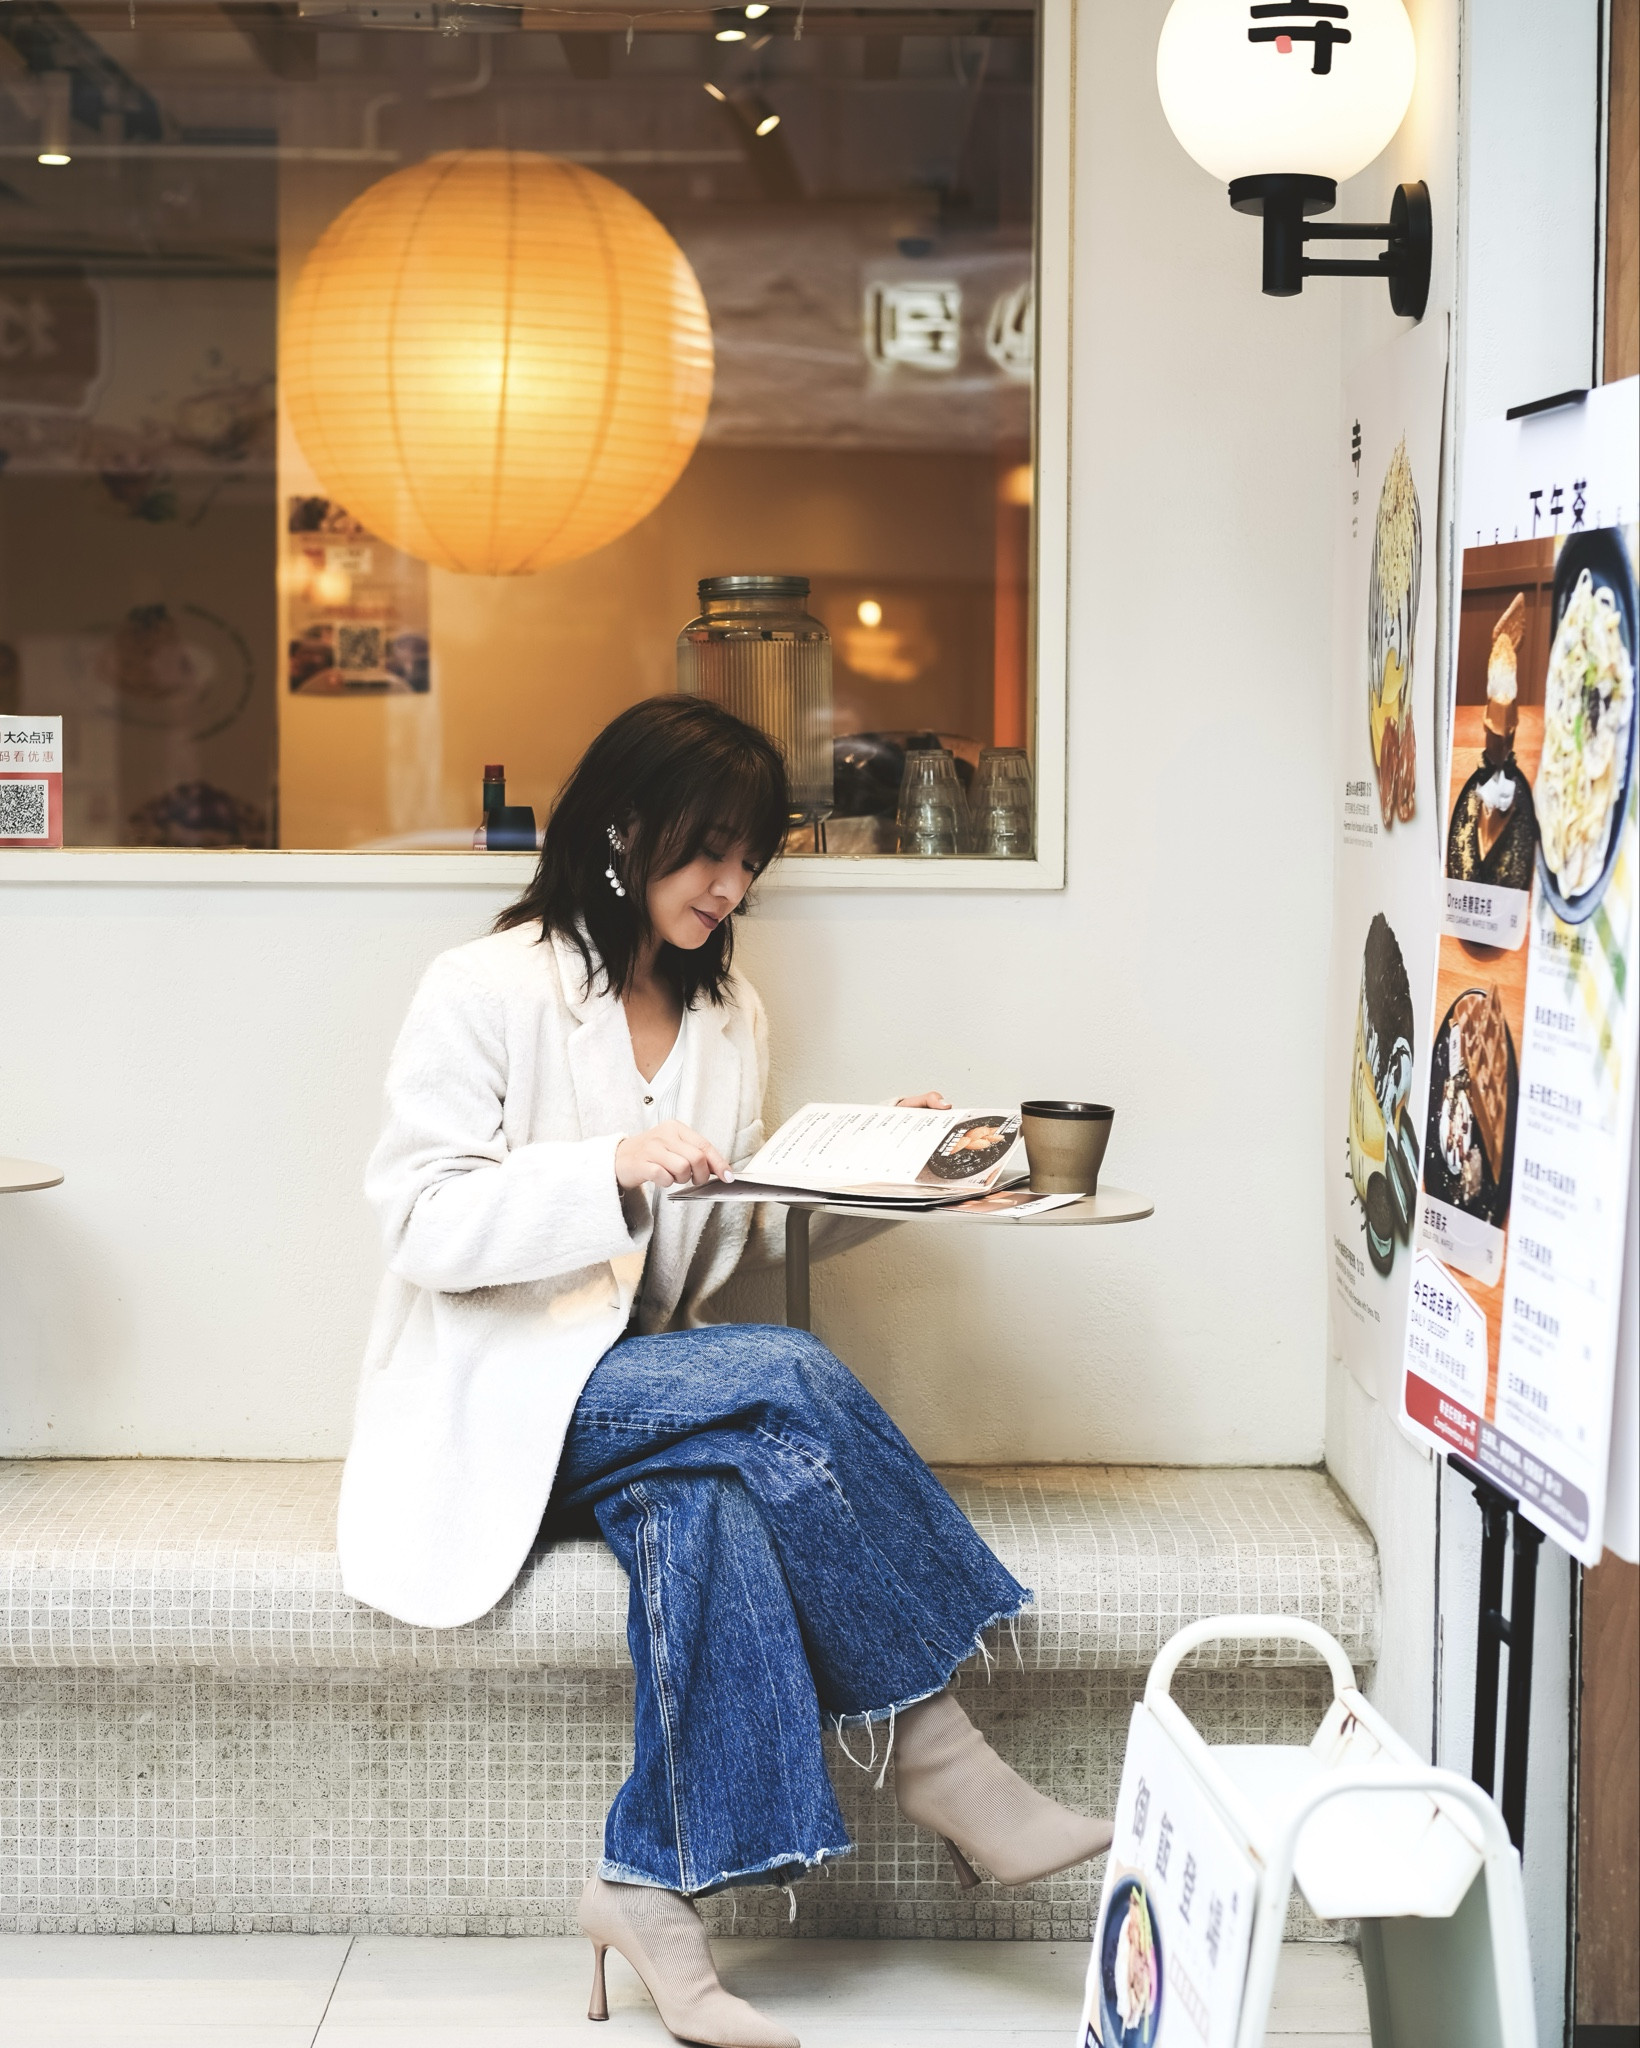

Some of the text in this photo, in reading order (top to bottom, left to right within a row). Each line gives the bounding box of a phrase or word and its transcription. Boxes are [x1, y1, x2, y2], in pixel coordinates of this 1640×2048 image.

[1530, 477, 1587, 539] 下午茶
[4, 731, 54, 744] 大众点评
[0, 750, 54, 763] 码看优惠
